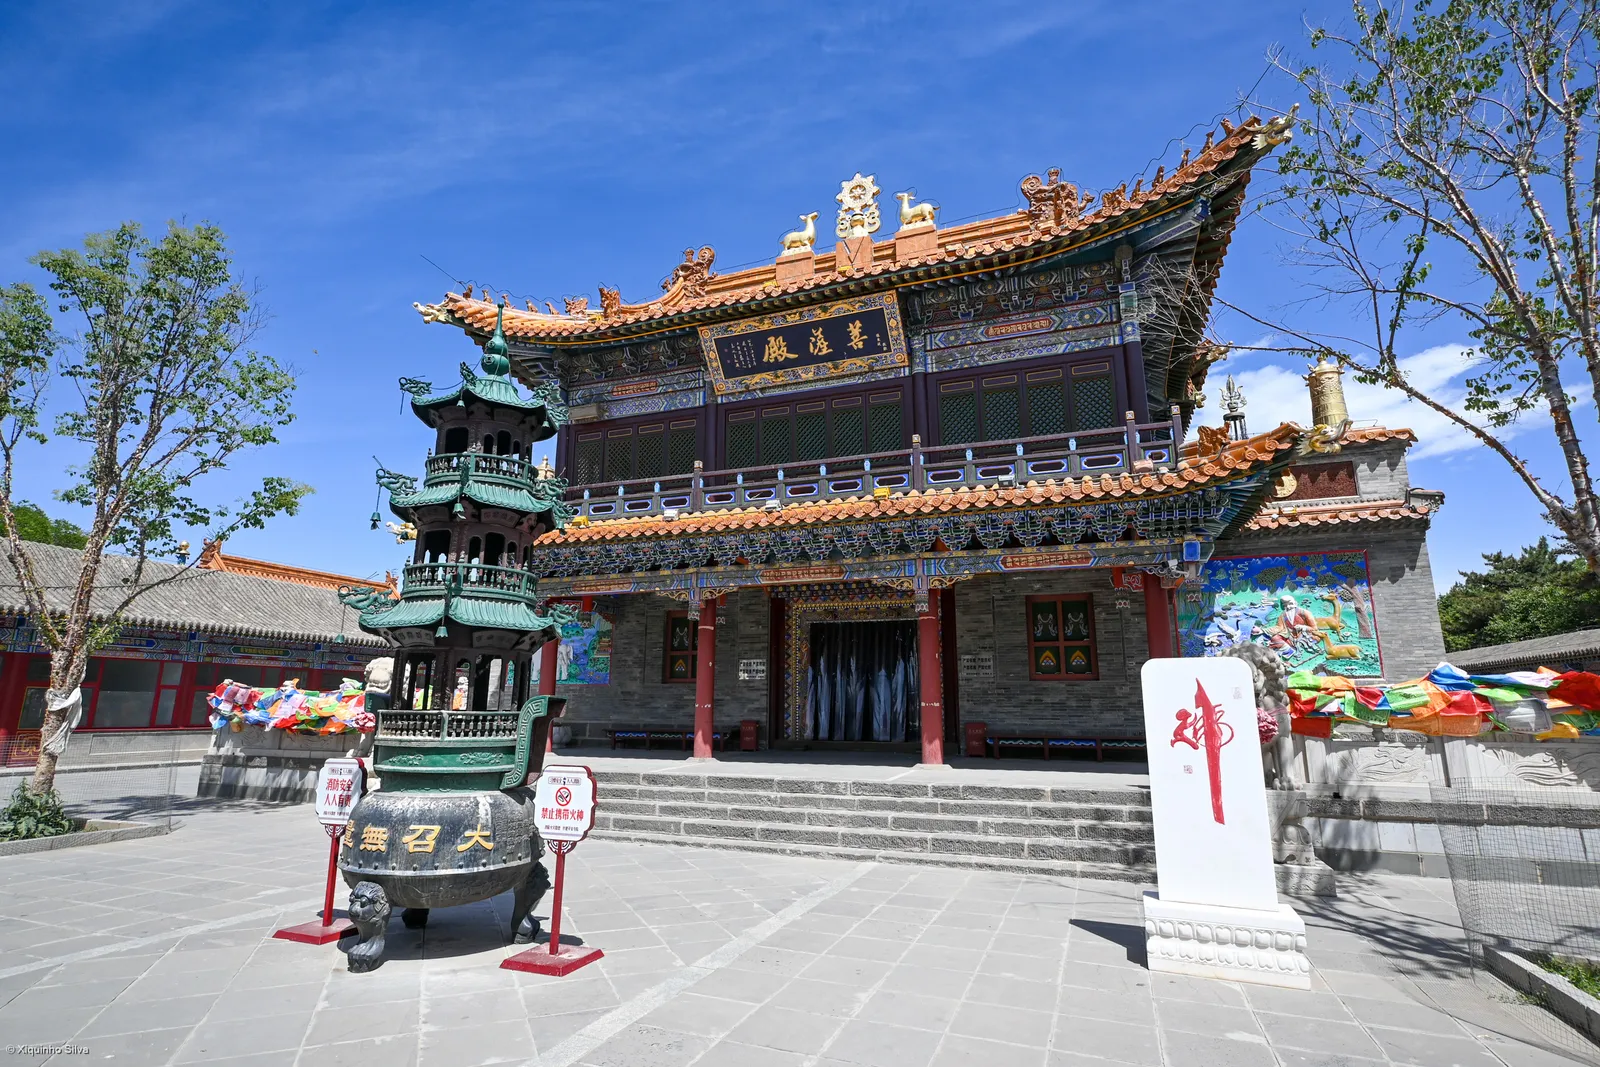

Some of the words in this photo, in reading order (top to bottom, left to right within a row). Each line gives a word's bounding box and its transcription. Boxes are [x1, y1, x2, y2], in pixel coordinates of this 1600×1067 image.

[326, 778, 353, 791] 消防安全
[541, 807, 584, 821] 禁止携带火种
